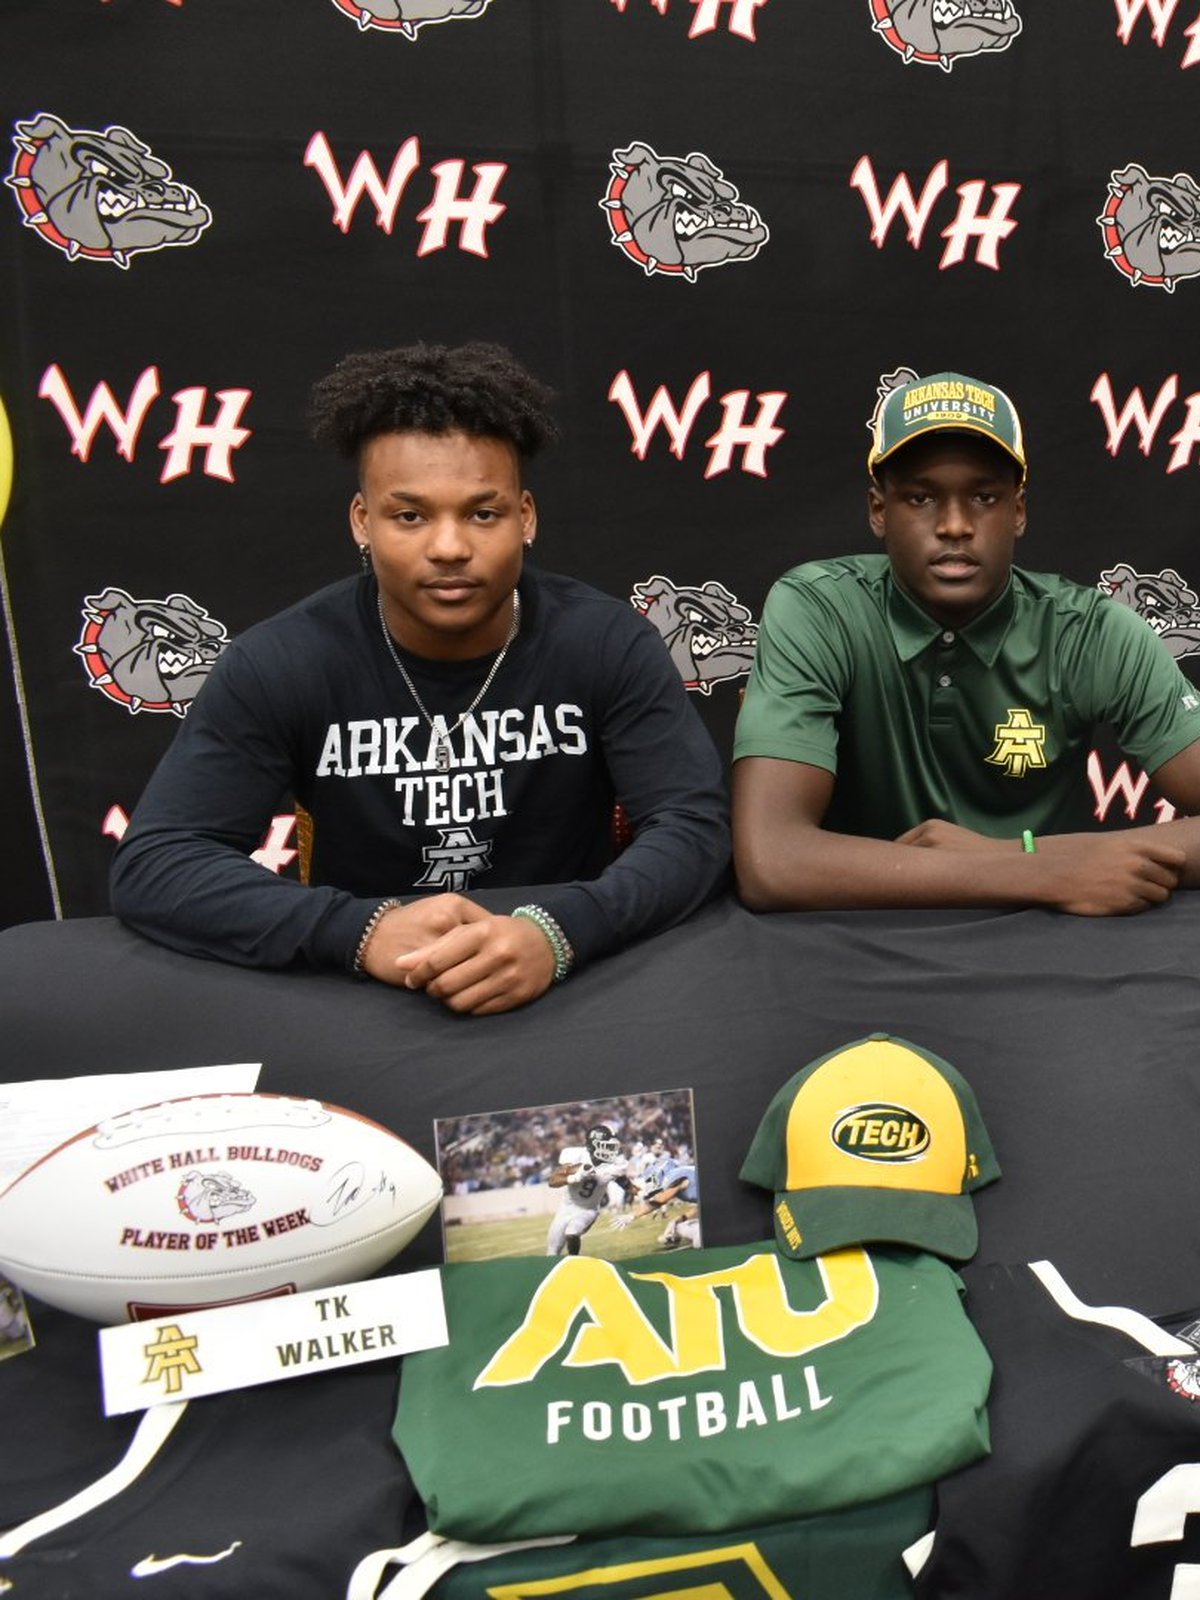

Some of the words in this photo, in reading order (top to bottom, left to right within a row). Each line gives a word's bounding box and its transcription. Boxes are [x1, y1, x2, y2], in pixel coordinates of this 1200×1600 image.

[303, 131, 507, 258] WH
[850, 155, 1021, 271] WH
[39, 364, 252, 483] WH
[609, 370, 787, 479] WH
[903, 400, 995, 421] UNIVERSITY
[904, 382, 964, 410] ARKANSAS
[965, 384, 996, 412] TECH
[315, 703, 588, 778] ARKANSAS
[395, 768, 508, 827] TECH
[846, 1118, 920, 1148] TECH
[104, 1158, 164, 1194] WHITE
[168, 1149, 220, 1171] HALL
[226, 1146, 324, 1173] BULLDOGS
[119, 1227, 191, 1251] PLAYER
[196, 1233, 219, 1251] OF
[222, 1225, 260, 1248] THE
[261, 1208, 312, 1238] WEEK
[315, 1295, 351, 1322] TK
[472, 1254, 880, 1392] ATU
[275, 1324, 398, 1368] WALKER
[546, 1365, 834, 1445] FOOTBALL
